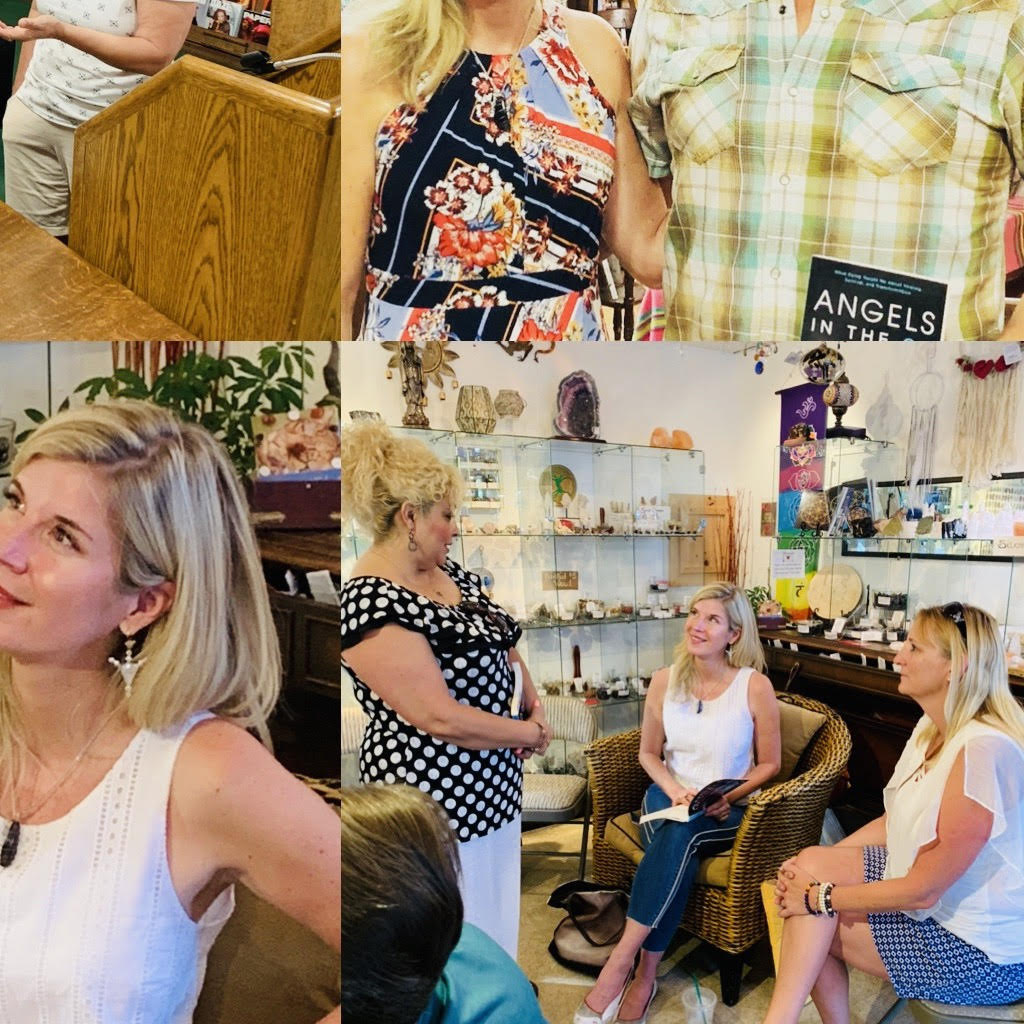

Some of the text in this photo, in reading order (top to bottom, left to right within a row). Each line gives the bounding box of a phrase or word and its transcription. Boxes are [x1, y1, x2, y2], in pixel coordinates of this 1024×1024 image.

[810, 317, 889, 341] IN THE
[813, 289, 936, 336] ANGELS
